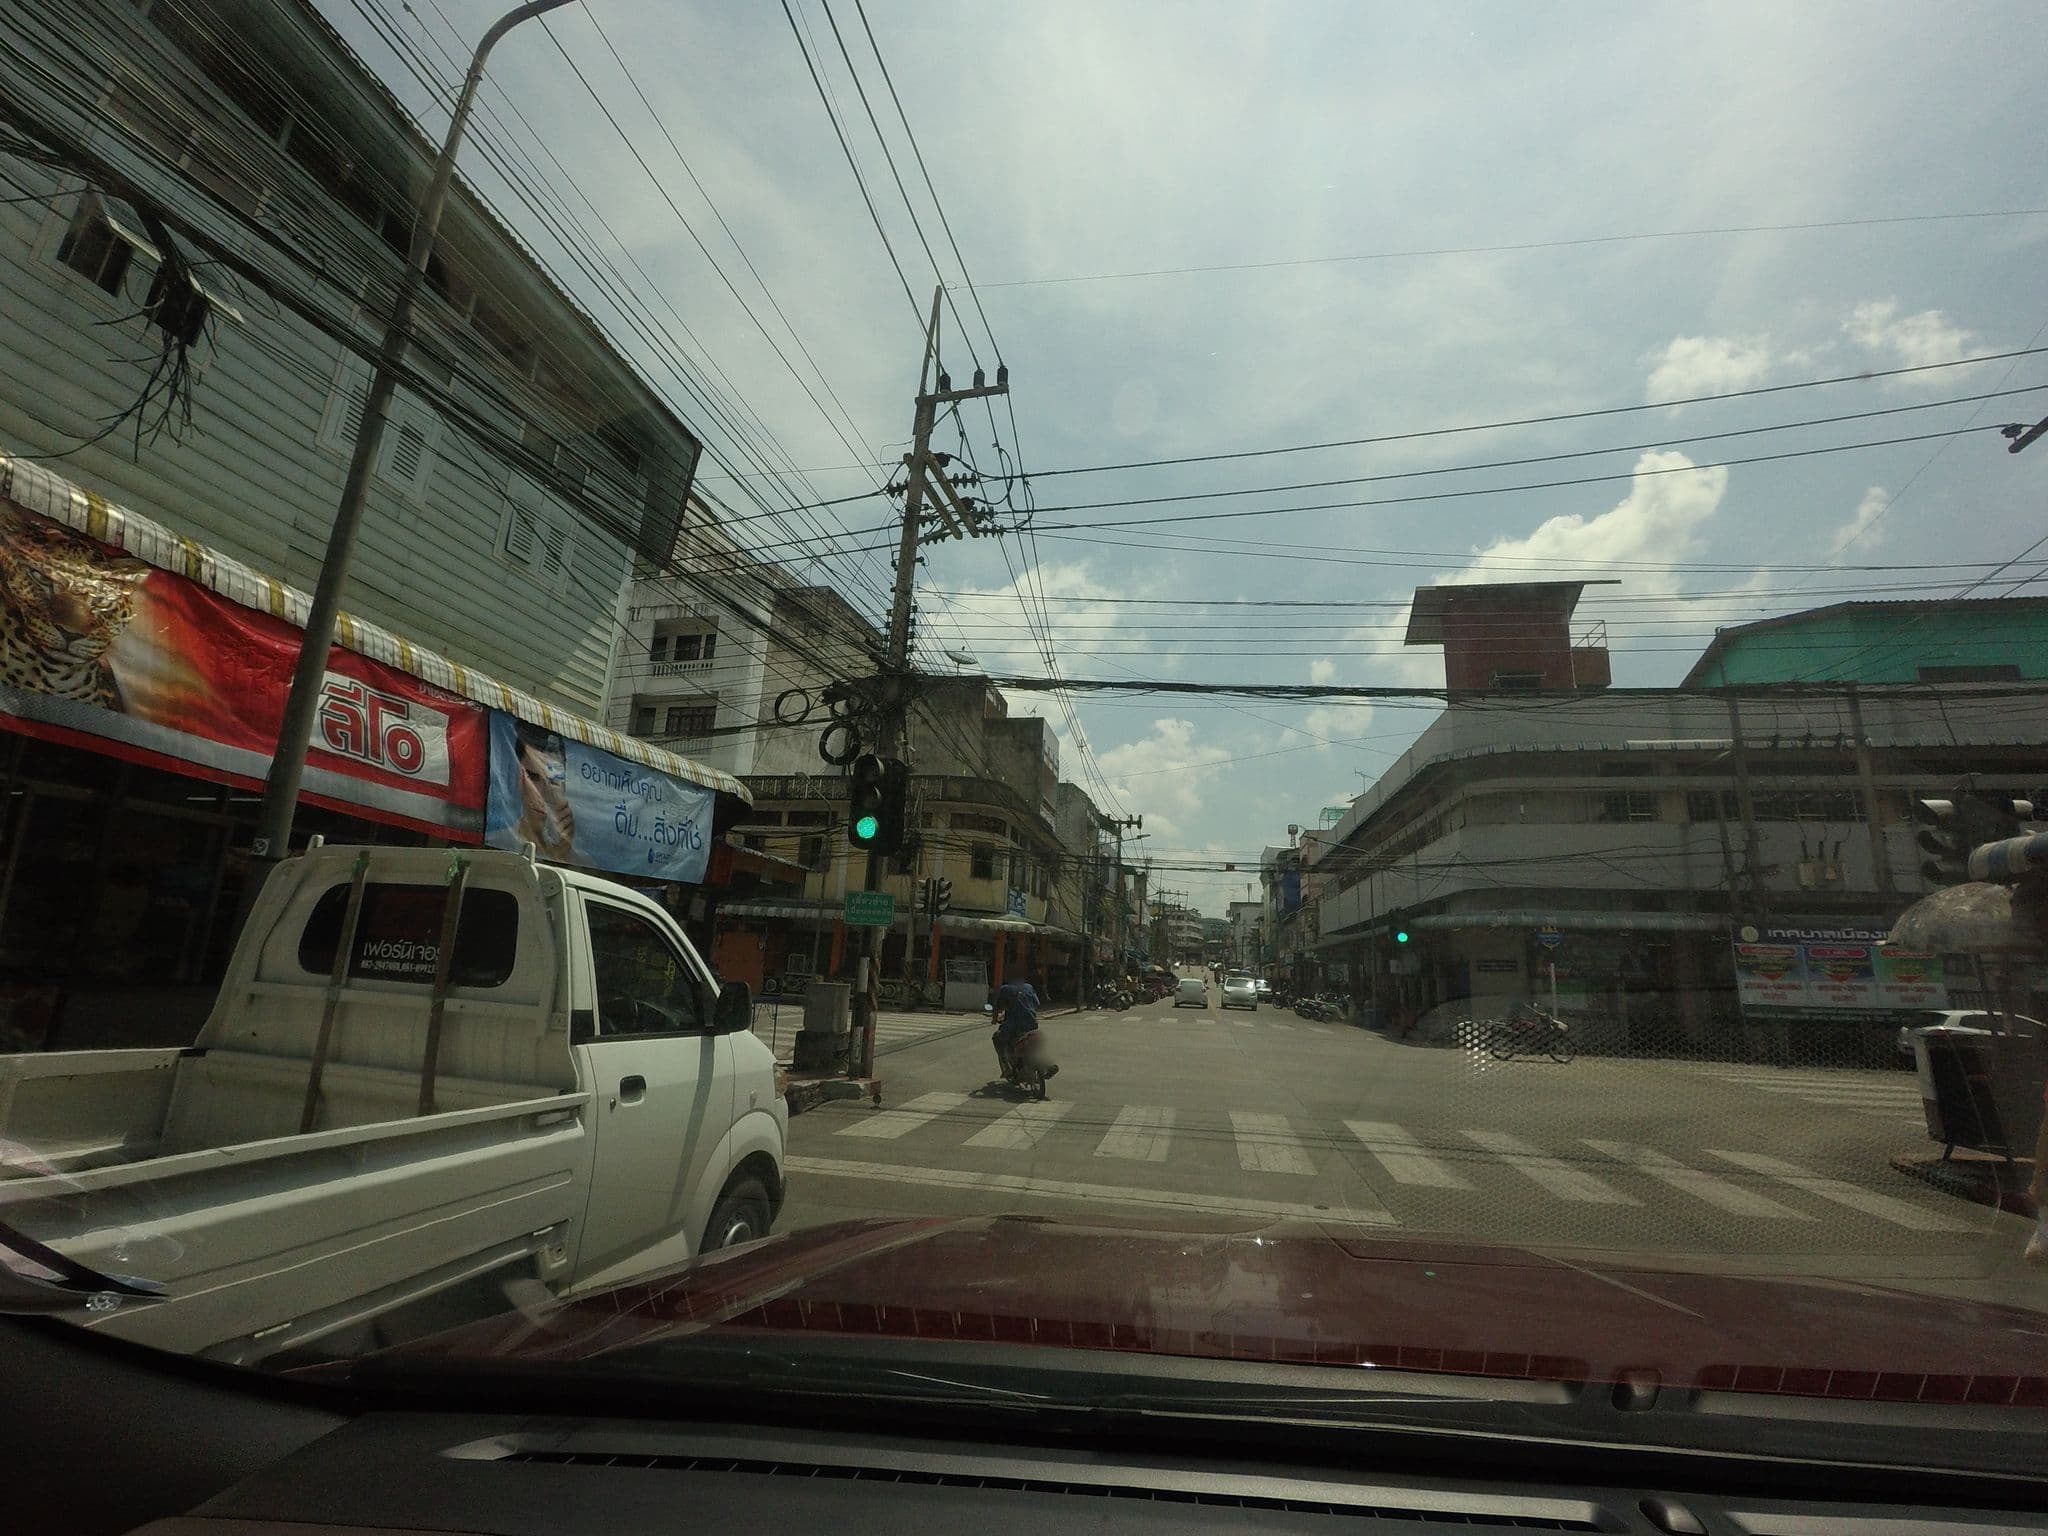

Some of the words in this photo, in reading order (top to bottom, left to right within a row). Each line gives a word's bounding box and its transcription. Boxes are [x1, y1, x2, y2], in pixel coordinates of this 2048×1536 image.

[581, 762, 662, 803] อยากเห็นคุณ
